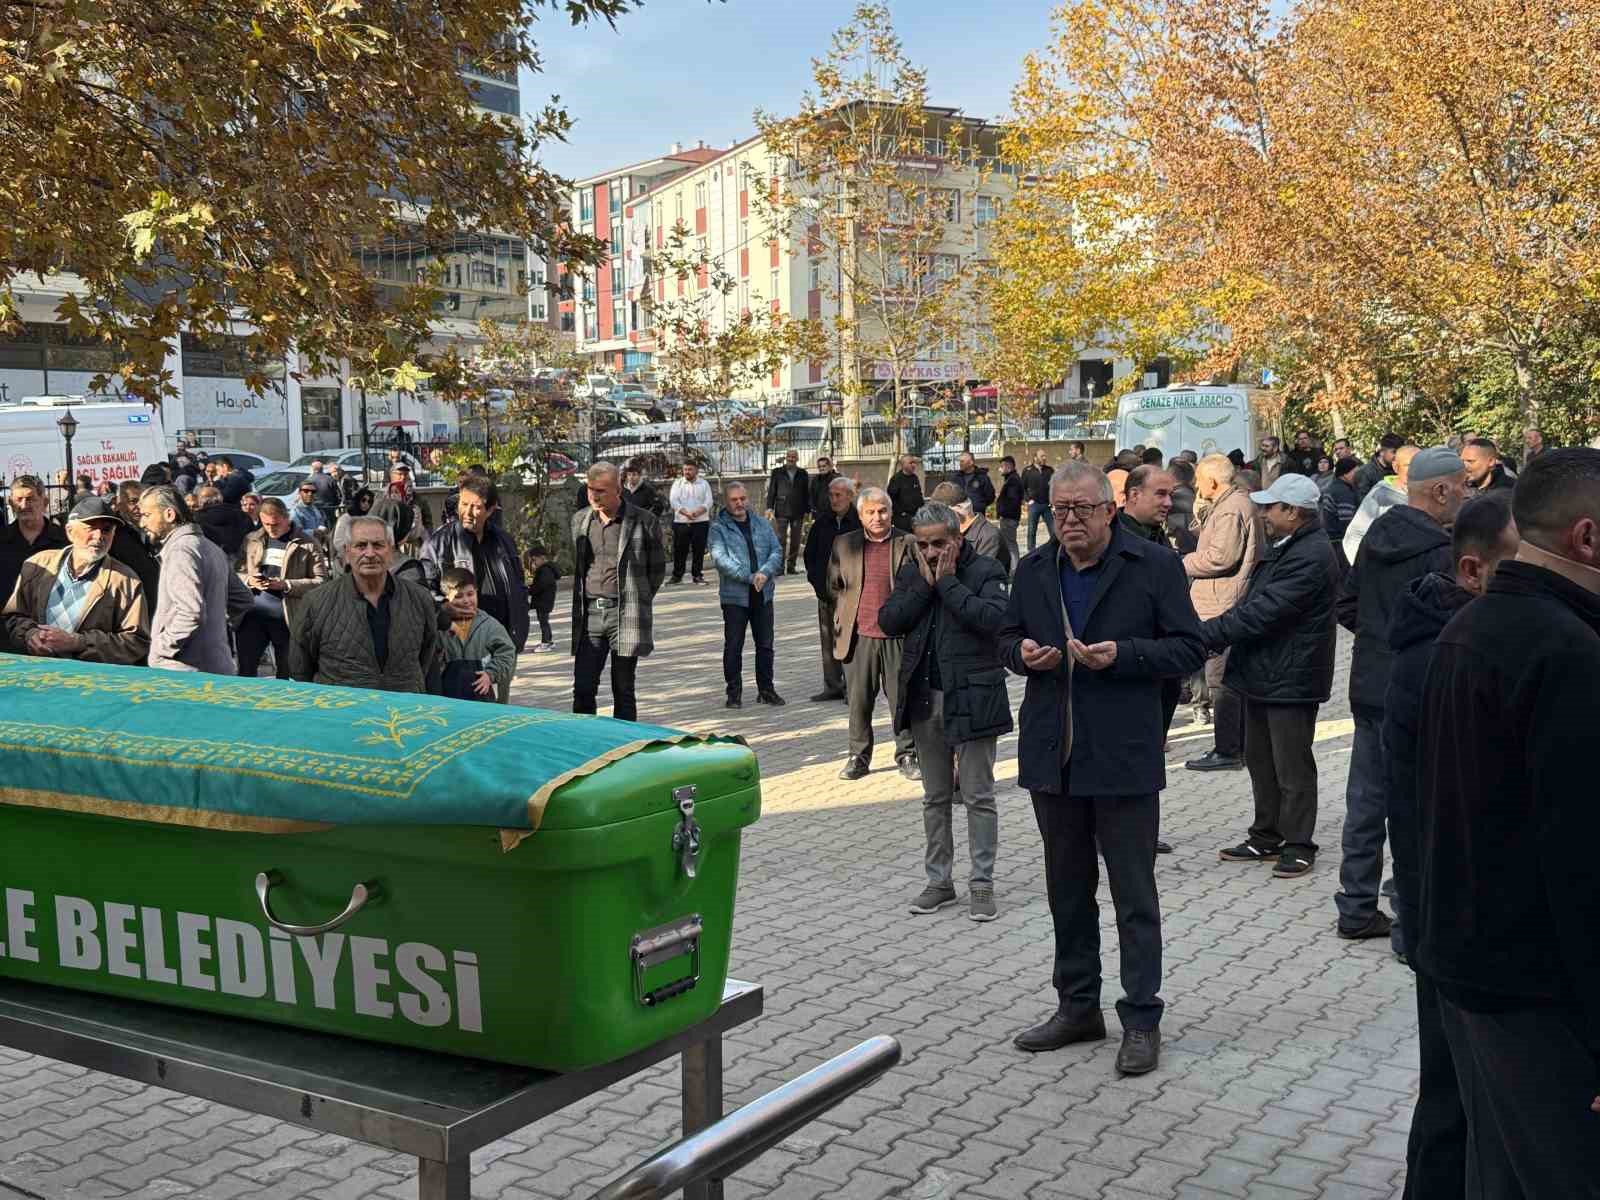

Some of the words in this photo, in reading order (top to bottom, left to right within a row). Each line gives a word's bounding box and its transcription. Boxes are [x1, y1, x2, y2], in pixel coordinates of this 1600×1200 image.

[102, 465, 140, 481] SAĞLIK
[0, 888, 40, 963] E
[55, 895, 482, 1033] BELEDİYESİ
